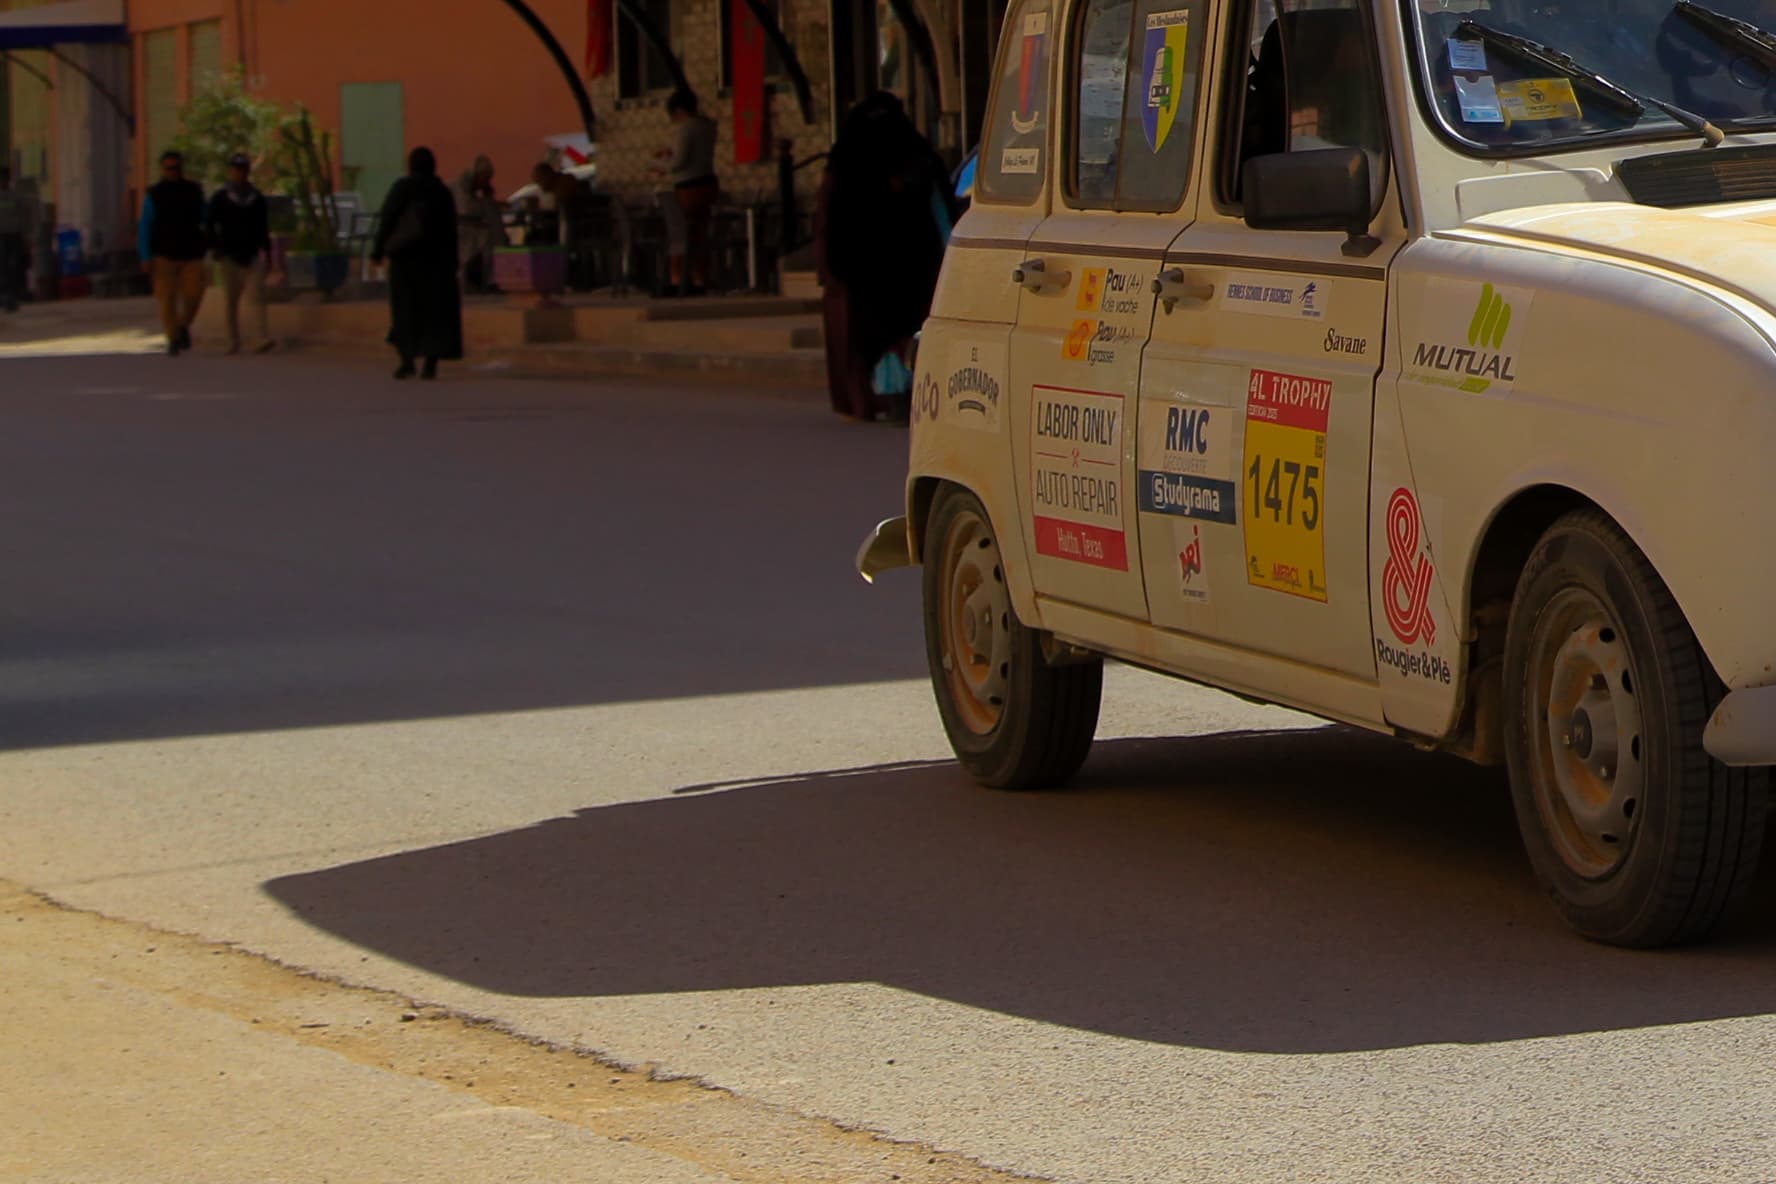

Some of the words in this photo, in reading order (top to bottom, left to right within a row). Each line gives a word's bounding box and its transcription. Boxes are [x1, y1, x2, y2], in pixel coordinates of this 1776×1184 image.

[1324, 327, 1367, 354] Savane
[1412, 342, 1515, 382] MUTUAL
[947, 367, 1000, 408] GOBERNADOR
[1249, 372, 1266, 401] 4L
[1272, 376, 1331, 411] TROPHY
[1037, 400, 1079, 441] LABOR
[1082, 407, 1117, 446] ONLY
[1165, 406, 1210, 455] RMC
[1036, 469, 1068, 509] AUTO
[1072, 475, 1118, 516] REPAIR
[1151, 473, 1220, 515] Studyrama
[1249, 454, 1320, 532] 1475
